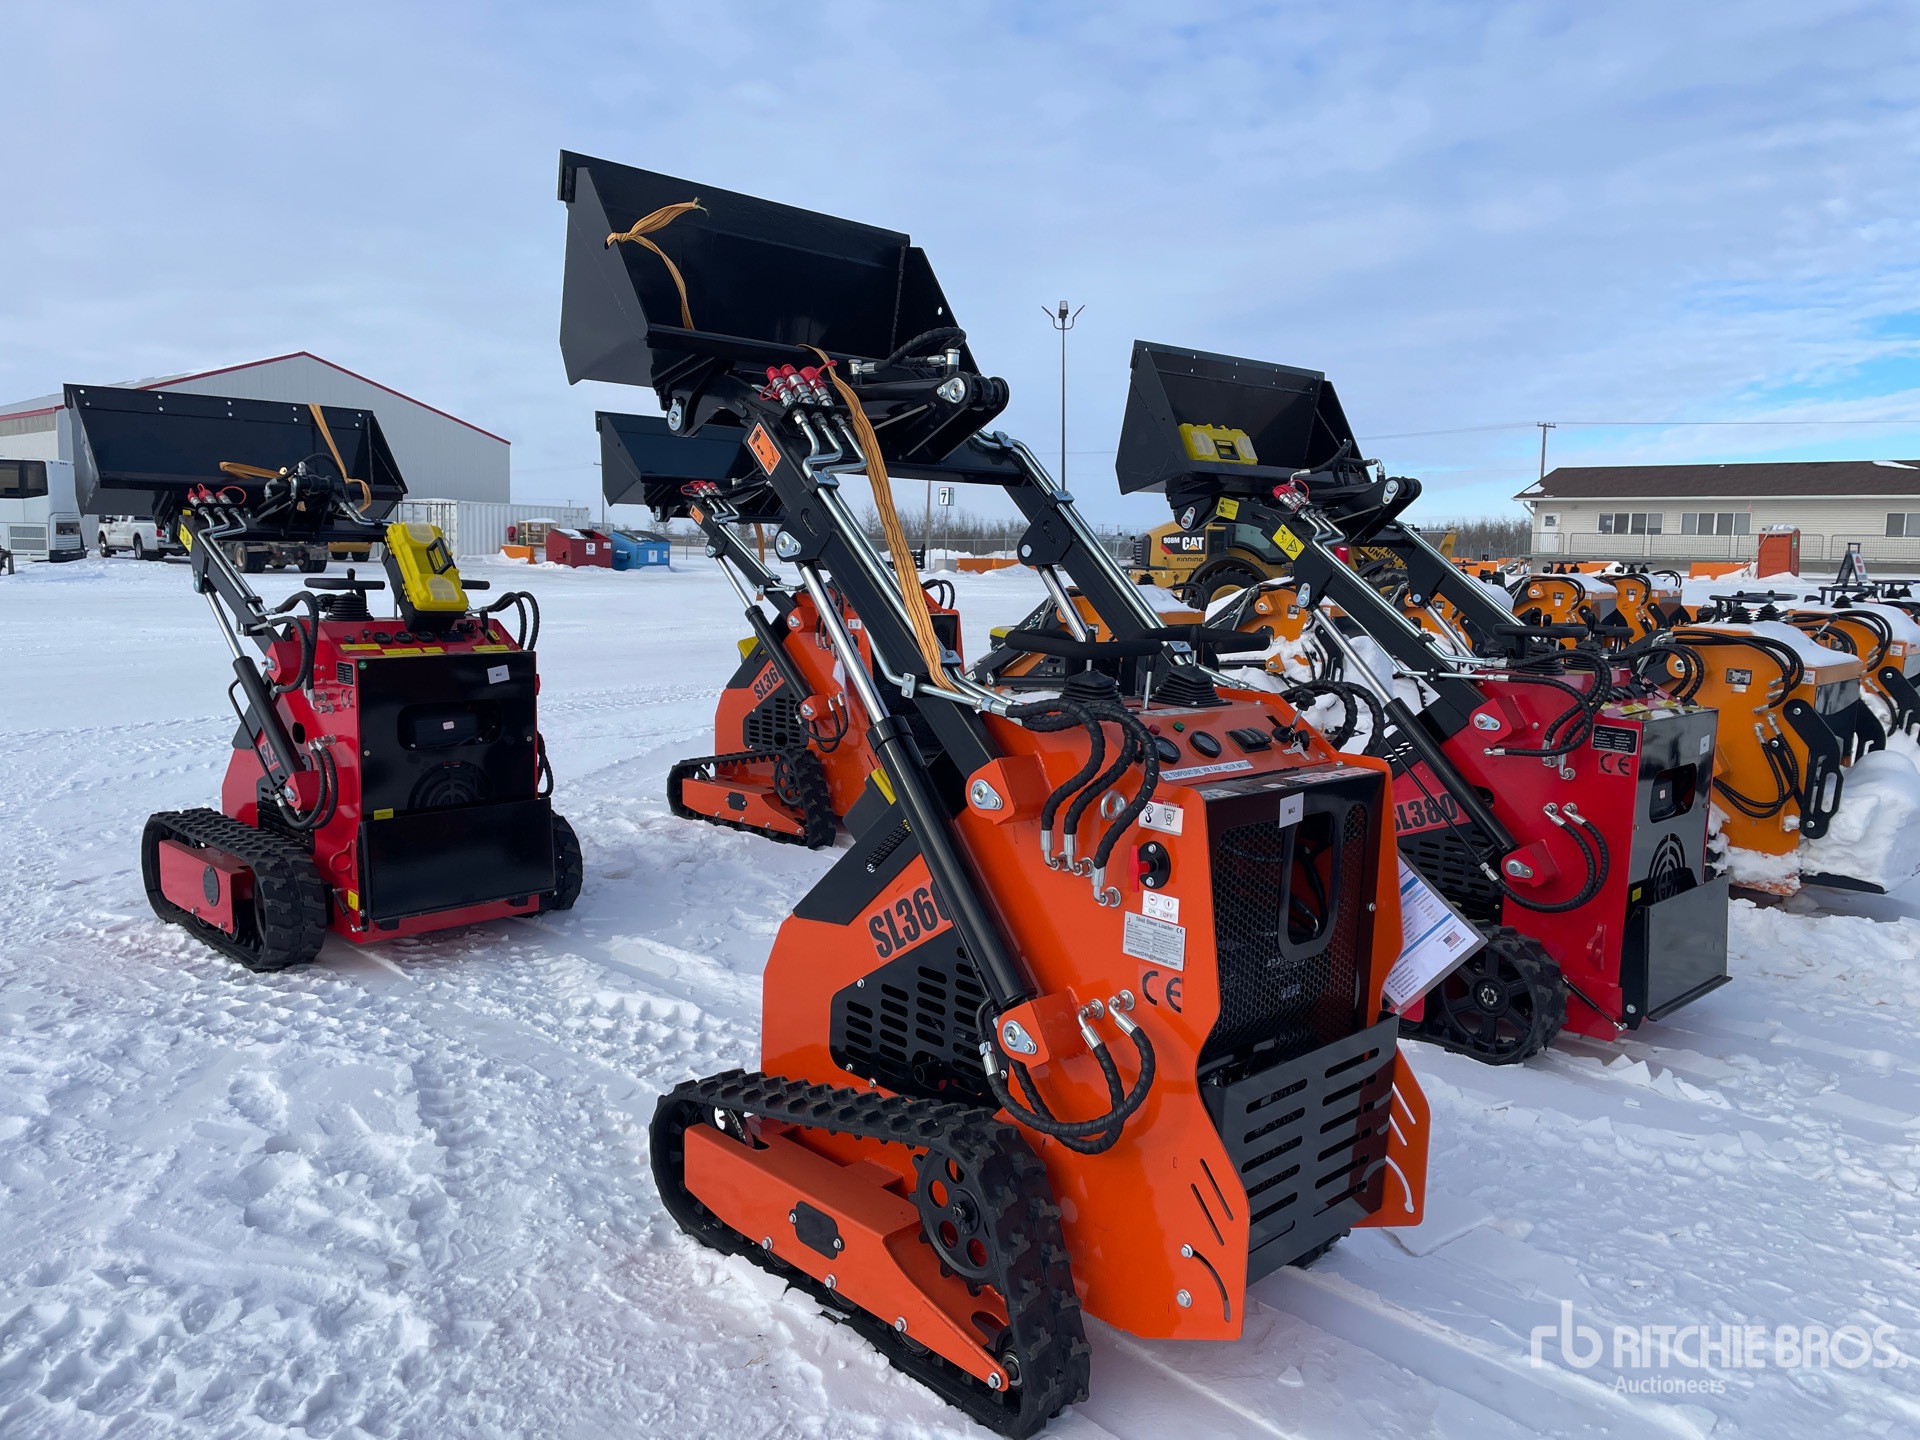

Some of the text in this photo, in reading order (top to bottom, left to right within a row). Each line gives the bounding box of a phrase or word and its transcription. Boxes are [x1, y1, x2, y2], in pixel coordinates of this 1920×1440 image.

[941, 492, 947, 503] 7
[1182, 536, 1204, 550] CAT
[753, 666, 780, 701] SL36
[1148, 907, 1157, 915] ON
[1136, 916, 1146, 924] Skid
[1146, 919, 1158, 927] Steer
[1158, 923, 1174, 931] Loader
[1142, 970, 1182, 1013] CE
